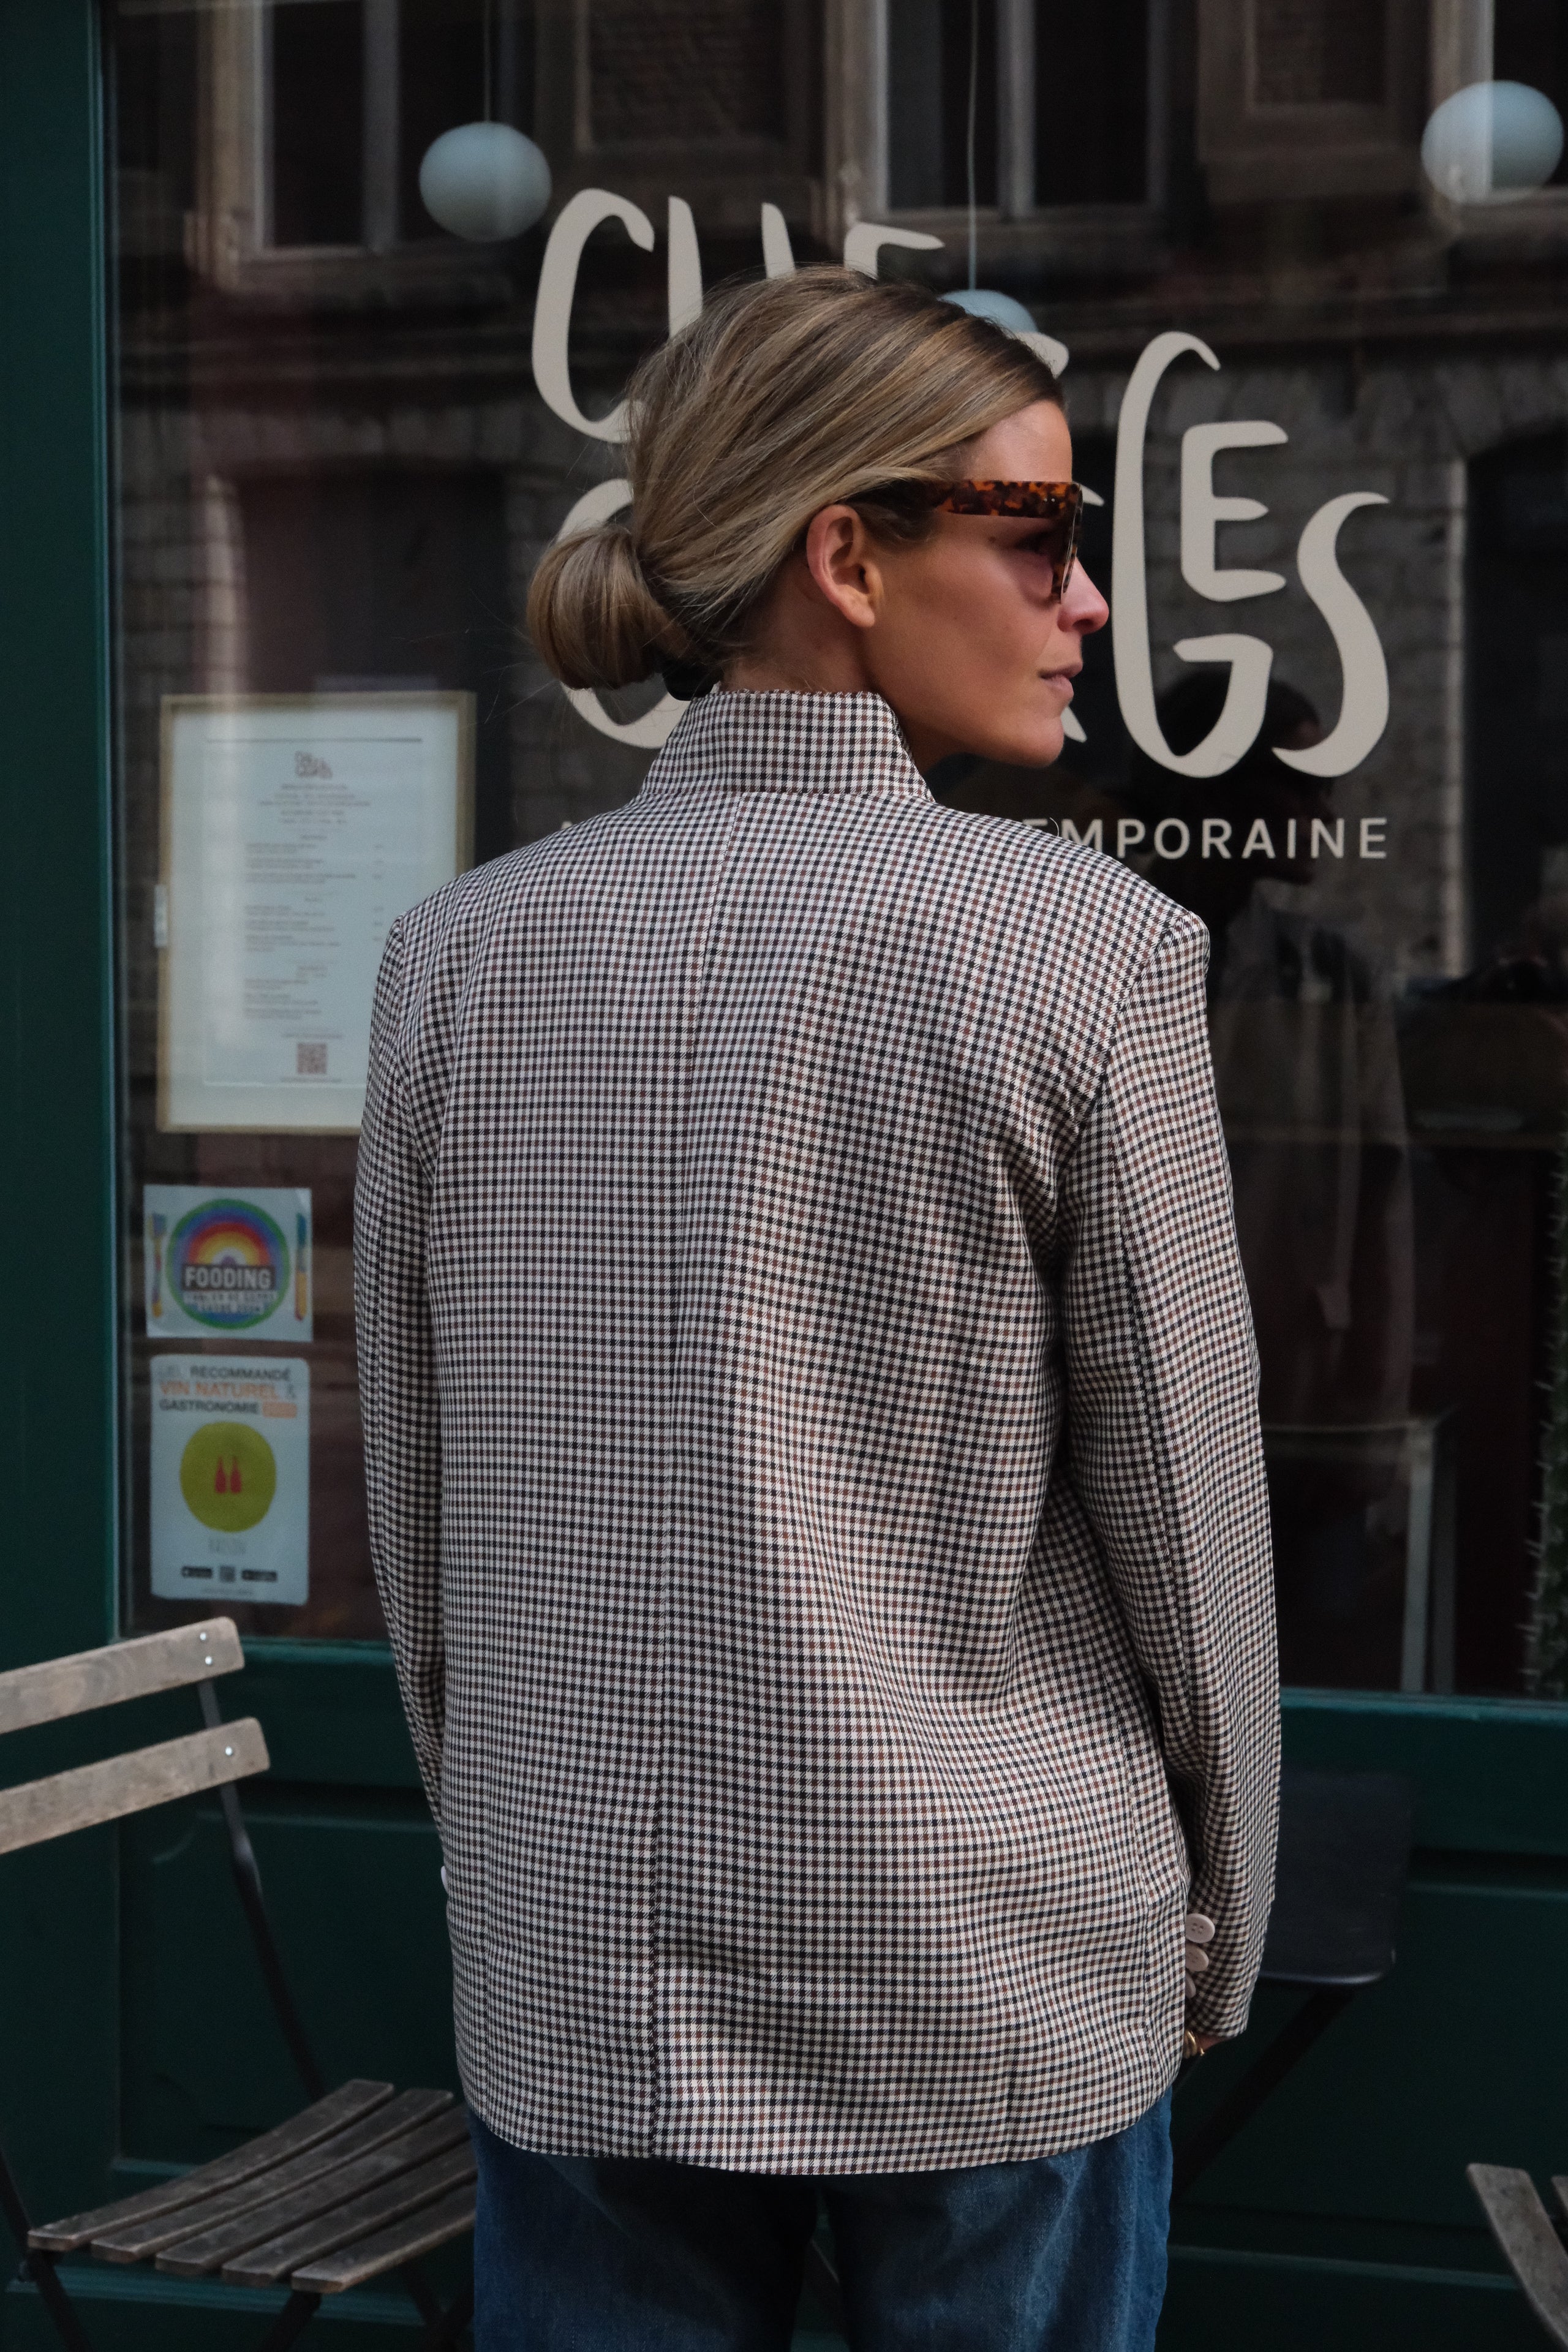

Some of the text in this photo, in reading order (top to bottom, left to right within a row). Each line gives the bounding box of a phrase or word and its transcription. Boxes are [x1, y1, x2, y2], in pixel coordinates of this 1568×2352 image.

[1023, 818, 1387, 860] MPORAINE
[185, 1267, 271, 1289] FOODING
[190, 1365, 290, 1381] RECOMMANDÉ
[160, 1381, 190, 1396] VIN
[195, 1382, 278, 1400] NATUREL
[159, 1399, 259, 1414] GASTRONOMIE
